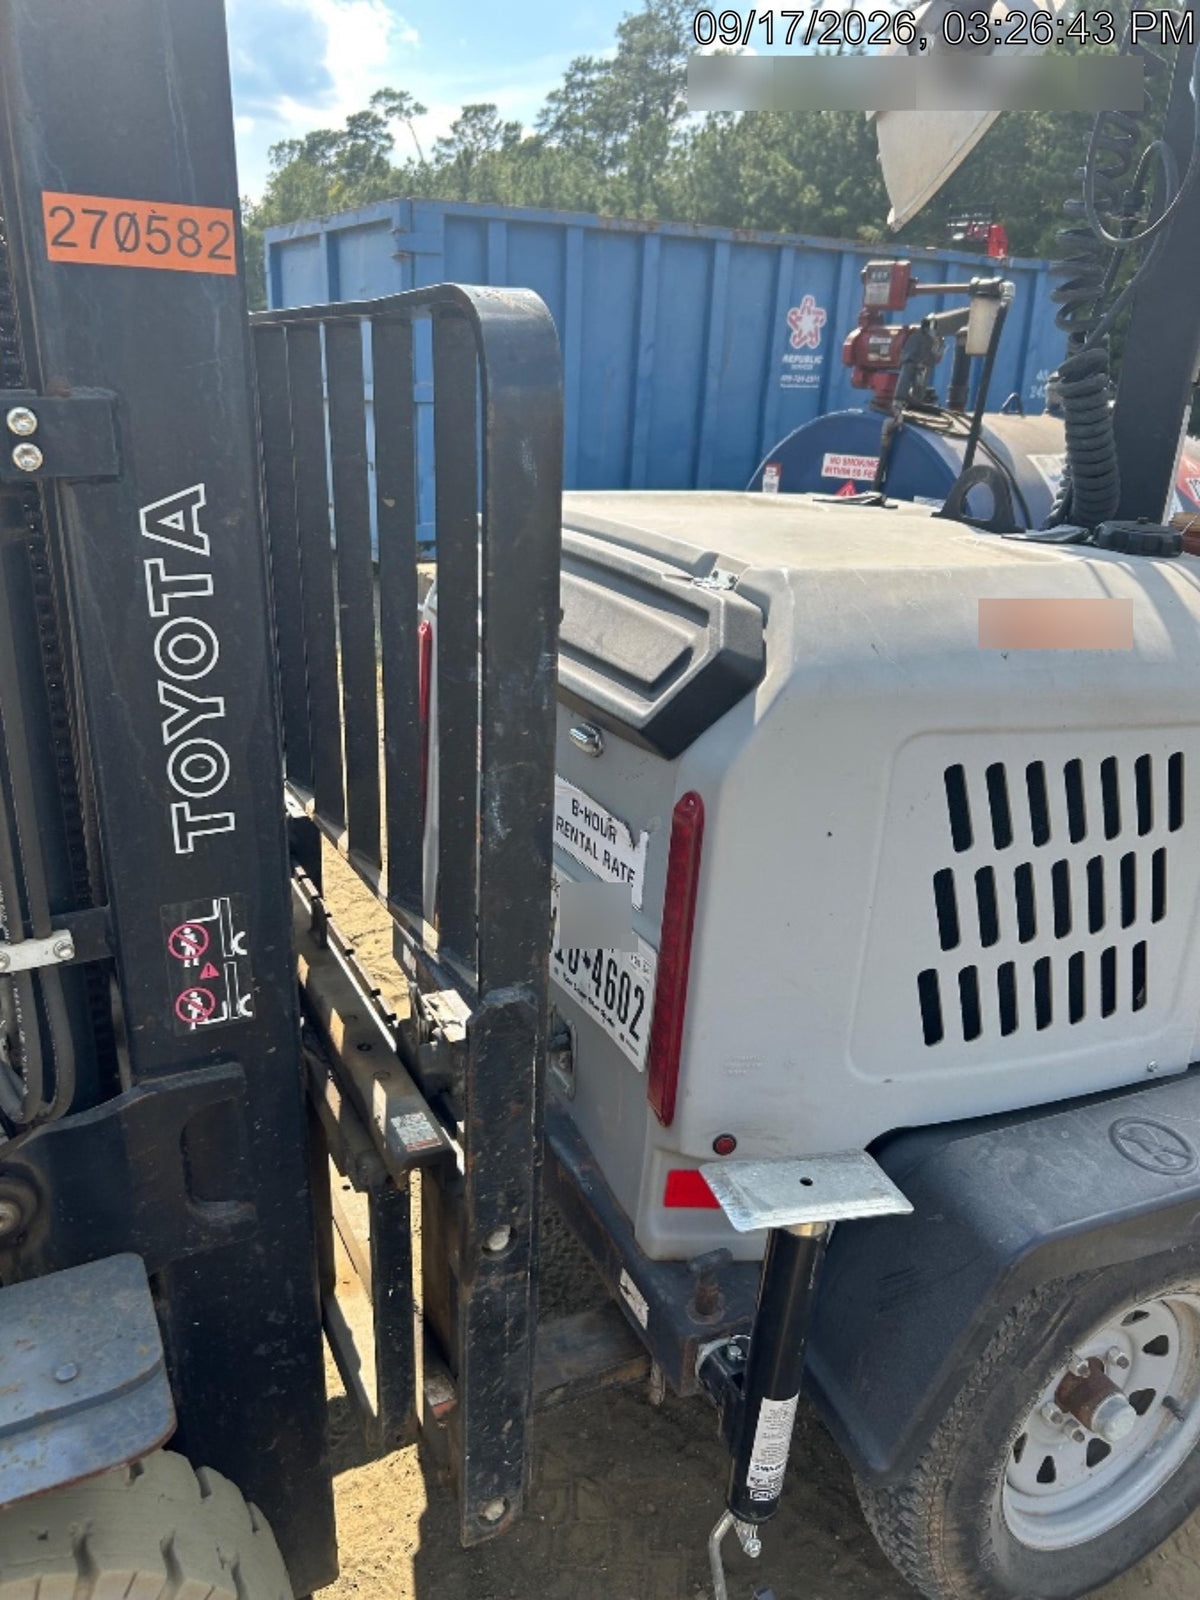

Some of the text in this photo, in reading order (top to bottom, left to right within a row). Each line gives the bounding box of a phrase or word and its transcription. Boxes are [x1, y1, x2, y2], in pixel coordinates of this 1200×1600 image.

[49, 205, 233, 261] 270582
[140, 483, 235, 854] TOYOTA
[556, 815, 636, 888] RENTAL RATE
